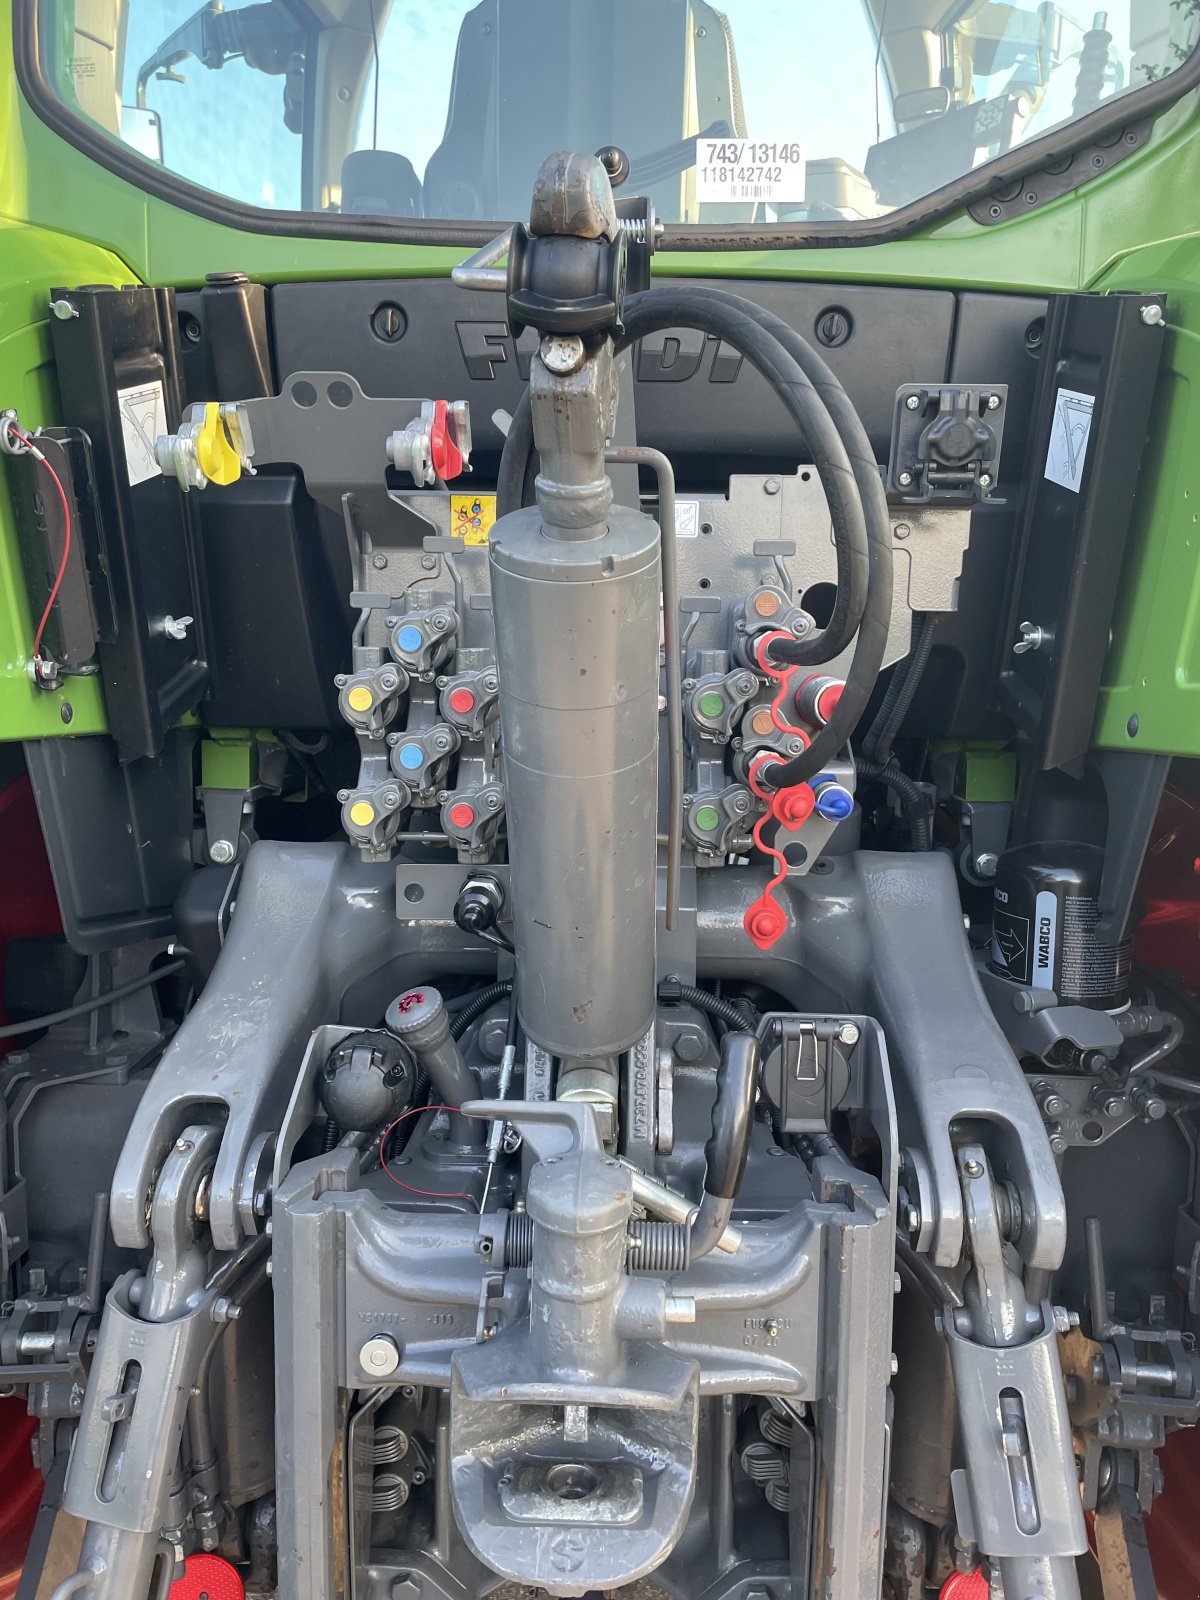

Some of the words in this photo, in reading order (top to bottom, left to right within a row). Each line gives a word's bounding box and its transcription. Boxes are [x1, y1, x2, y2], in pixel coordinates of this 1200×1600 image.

[706, 142, 801, 165] 743/13146
[700, 166, 782, 182] 118142742
[1038, 917, 1050, 968] WABCO
